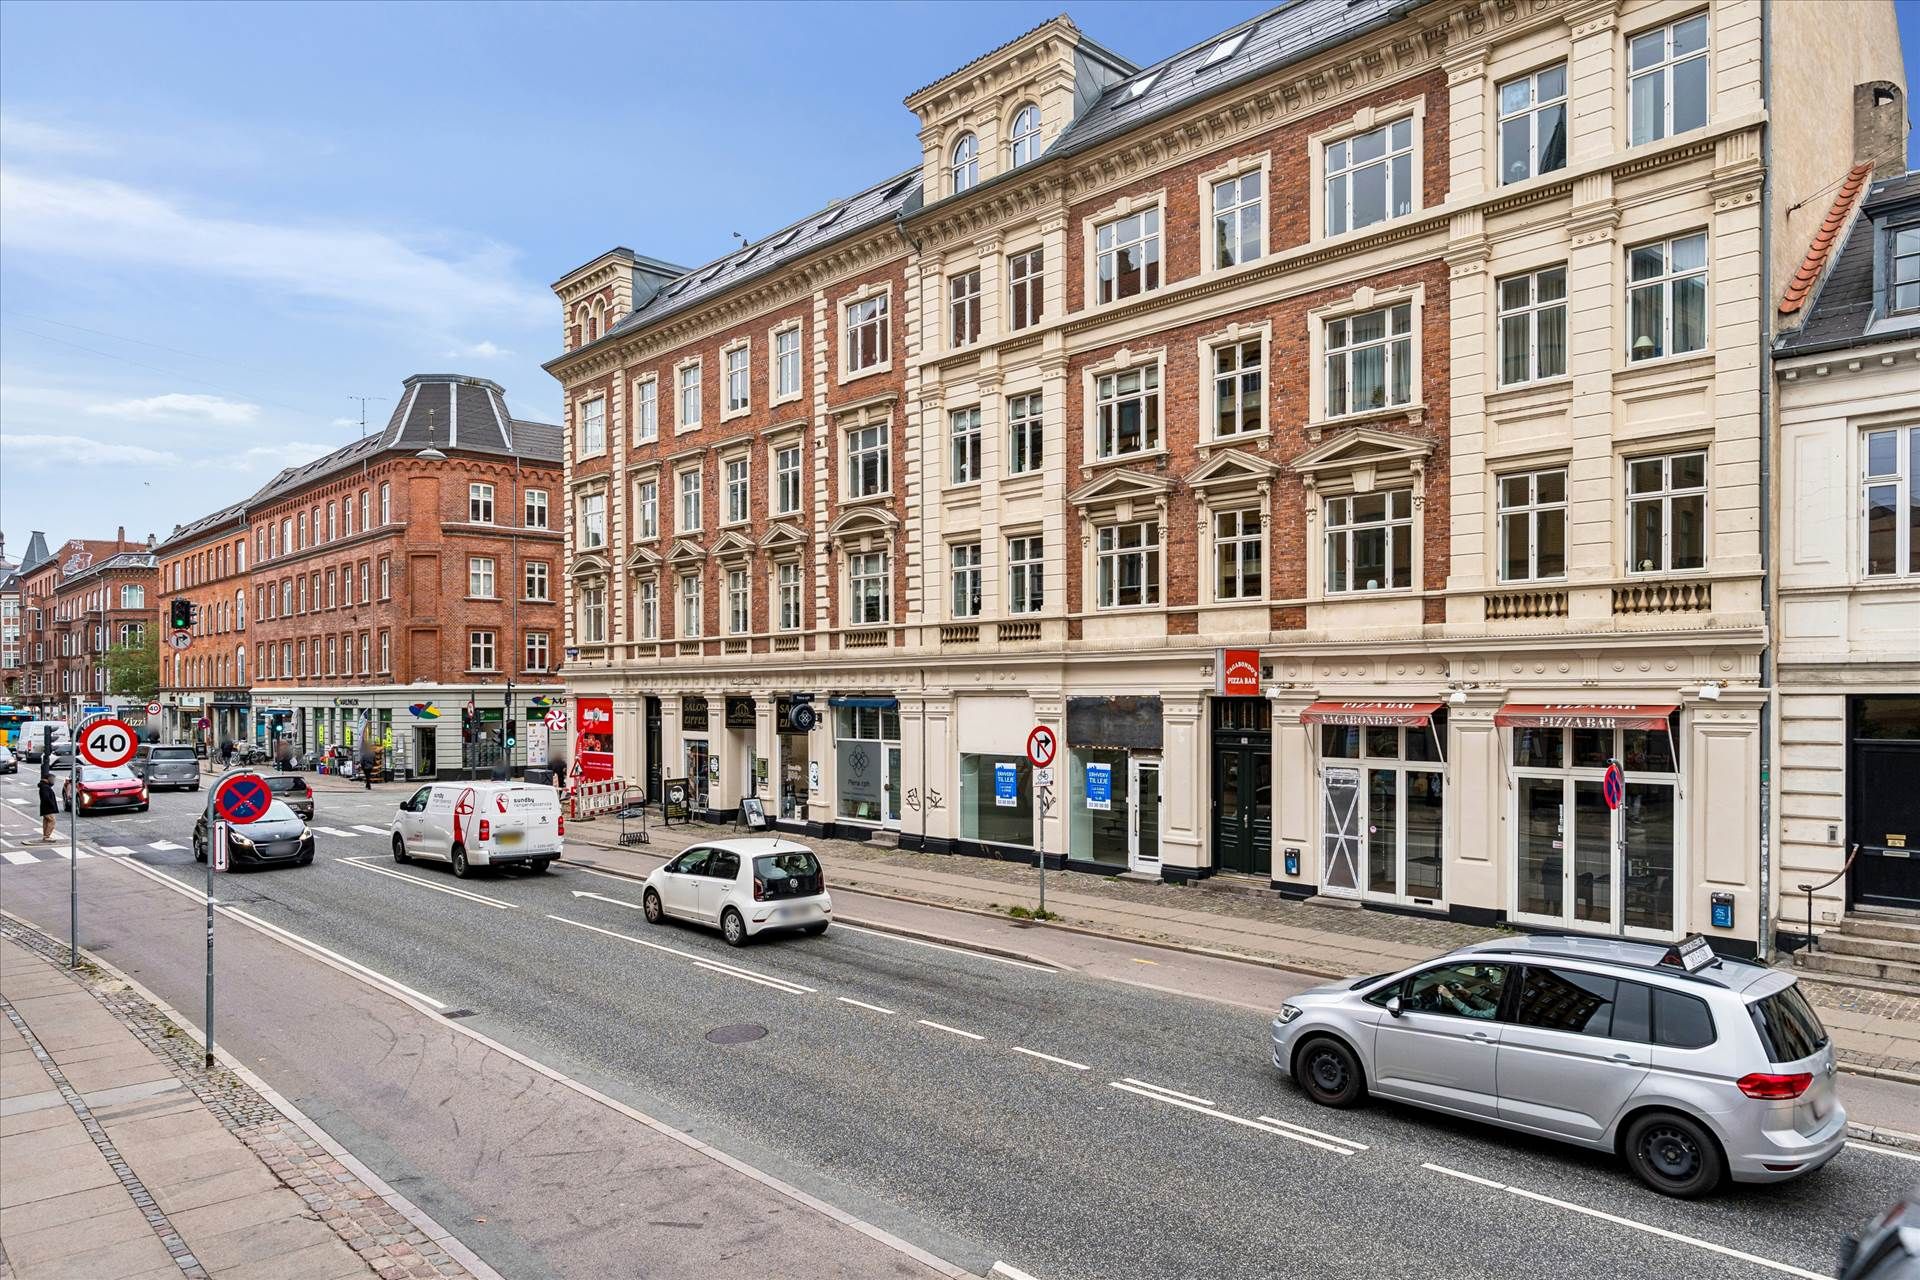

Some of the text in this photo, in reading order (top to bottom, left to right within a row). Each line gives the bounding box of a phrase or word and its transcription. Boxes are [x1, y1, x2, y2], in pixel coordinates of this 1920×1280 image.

[1226, 661, 1258, 677] VAGABONDO'S
[1321, 714, 1404, 725] VAGABONDO'S
[1539, 716, 1616, 729] PIZZA BAR
[91, 735, 126, 752] 40
